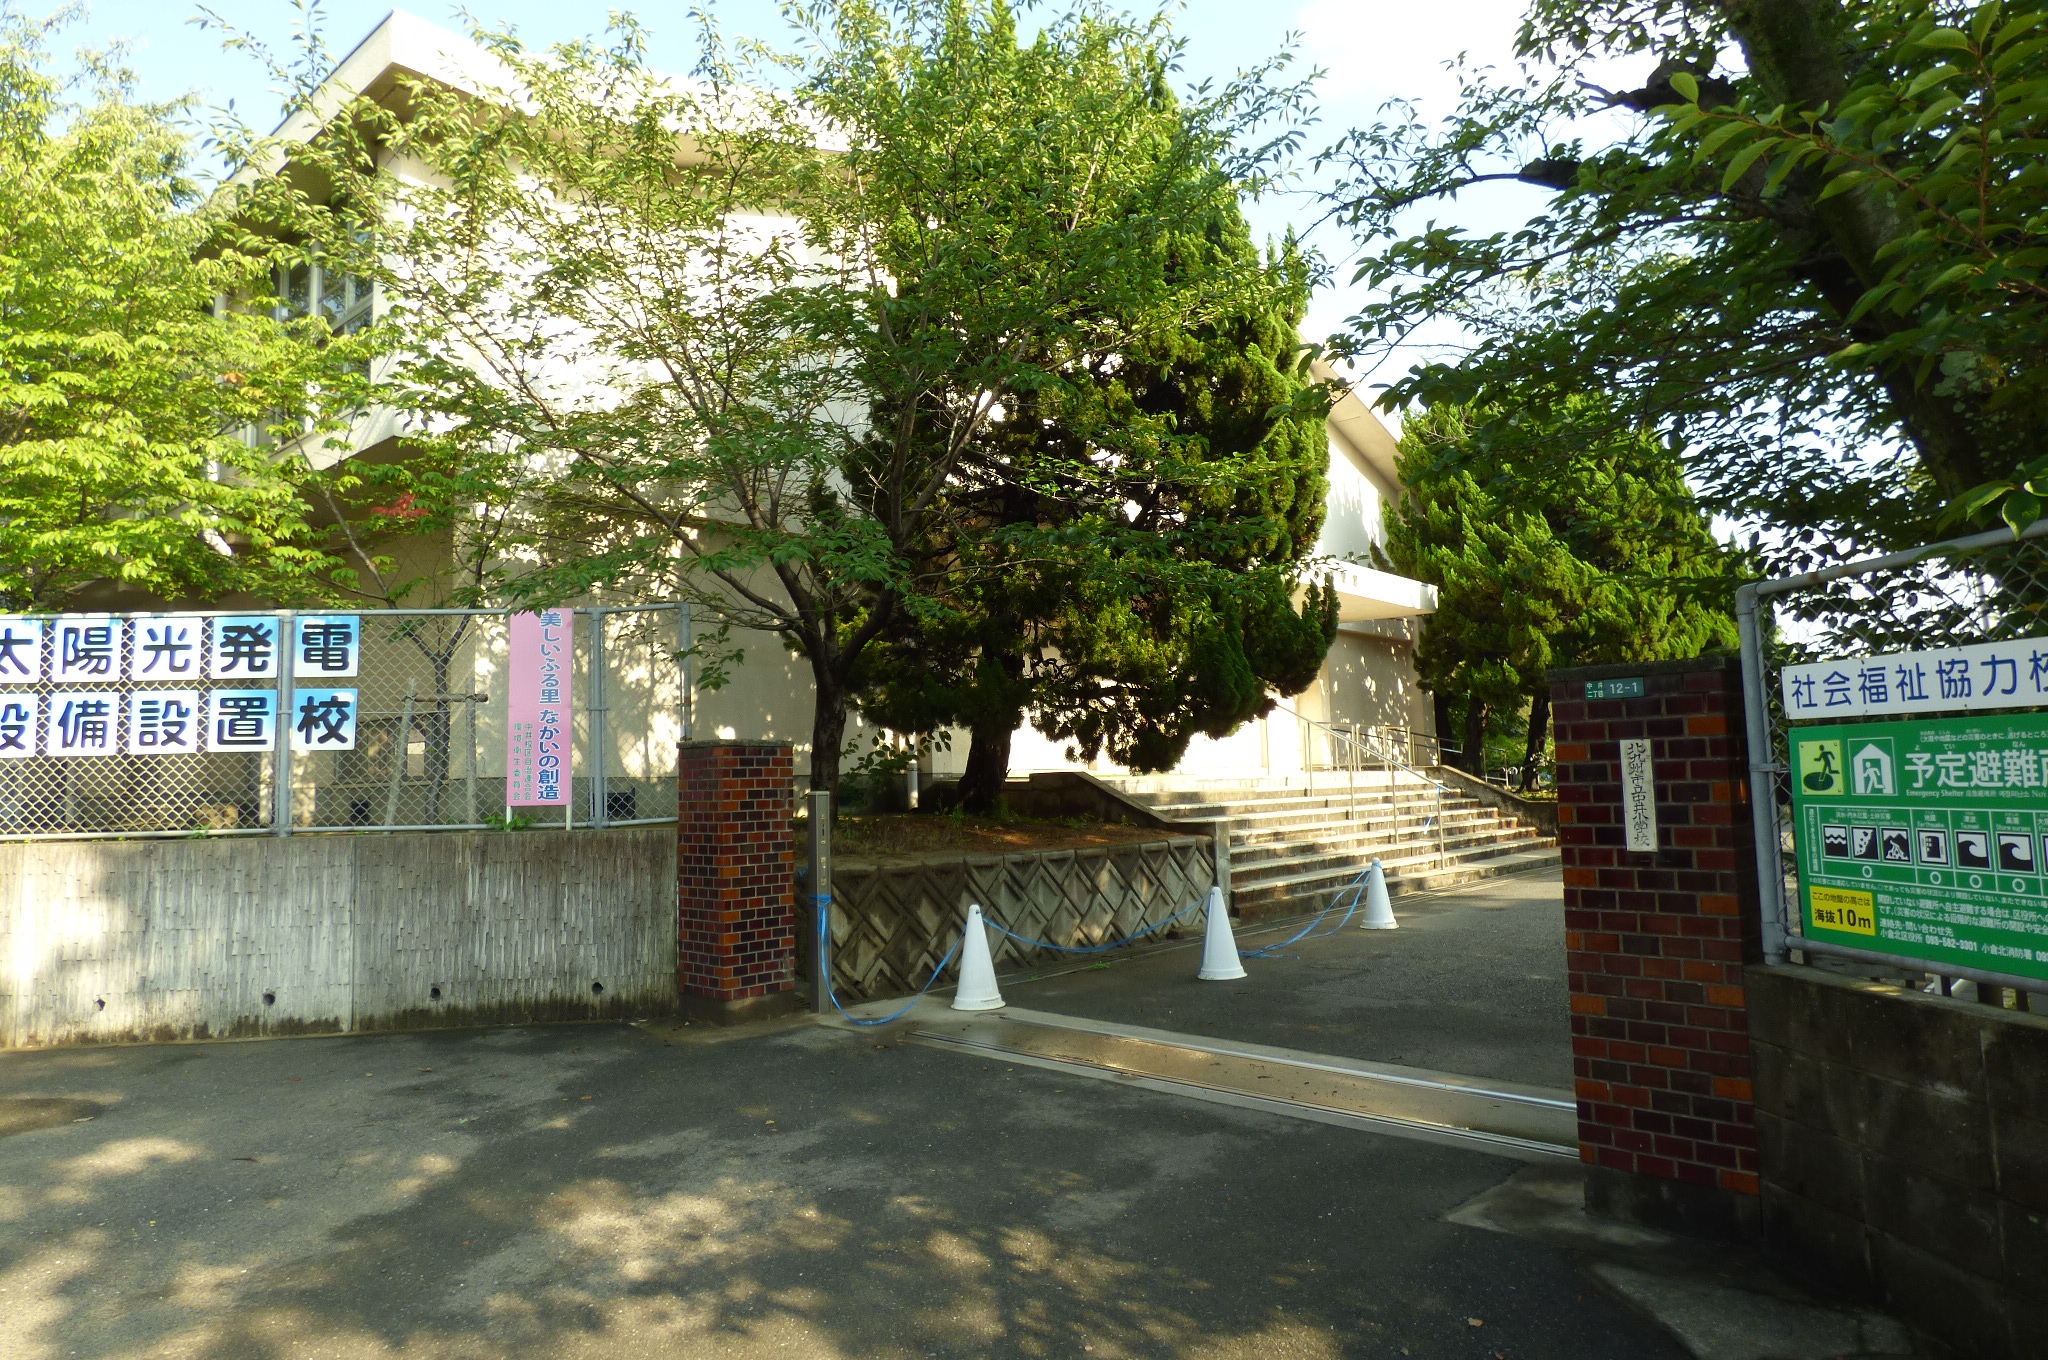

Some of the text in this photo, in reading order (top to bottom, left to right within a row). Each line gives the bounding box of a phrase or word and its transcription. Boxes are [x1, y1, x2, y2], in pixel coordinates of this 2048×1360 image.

[0, 623, 353, 675] 太陽光発電
[1587, 690, 1604, 698] 二丁目
[1610, 682, 1637, 694] 12-1
[538, 612, 561, 800] 美しいふる里 なかいの創造
[1904, 749, 2048, 788] 予定避難
[1627, 742, 1650, 847] 北九州市立中井小学校
[1906, 789, 1940, 798] Emergency
[1941, 789, 1964, 797] Shelter
[1812, 891, 1870, 907] ここの地盤の高さは
[1814, 908, 1871, 929] 海抜10m
